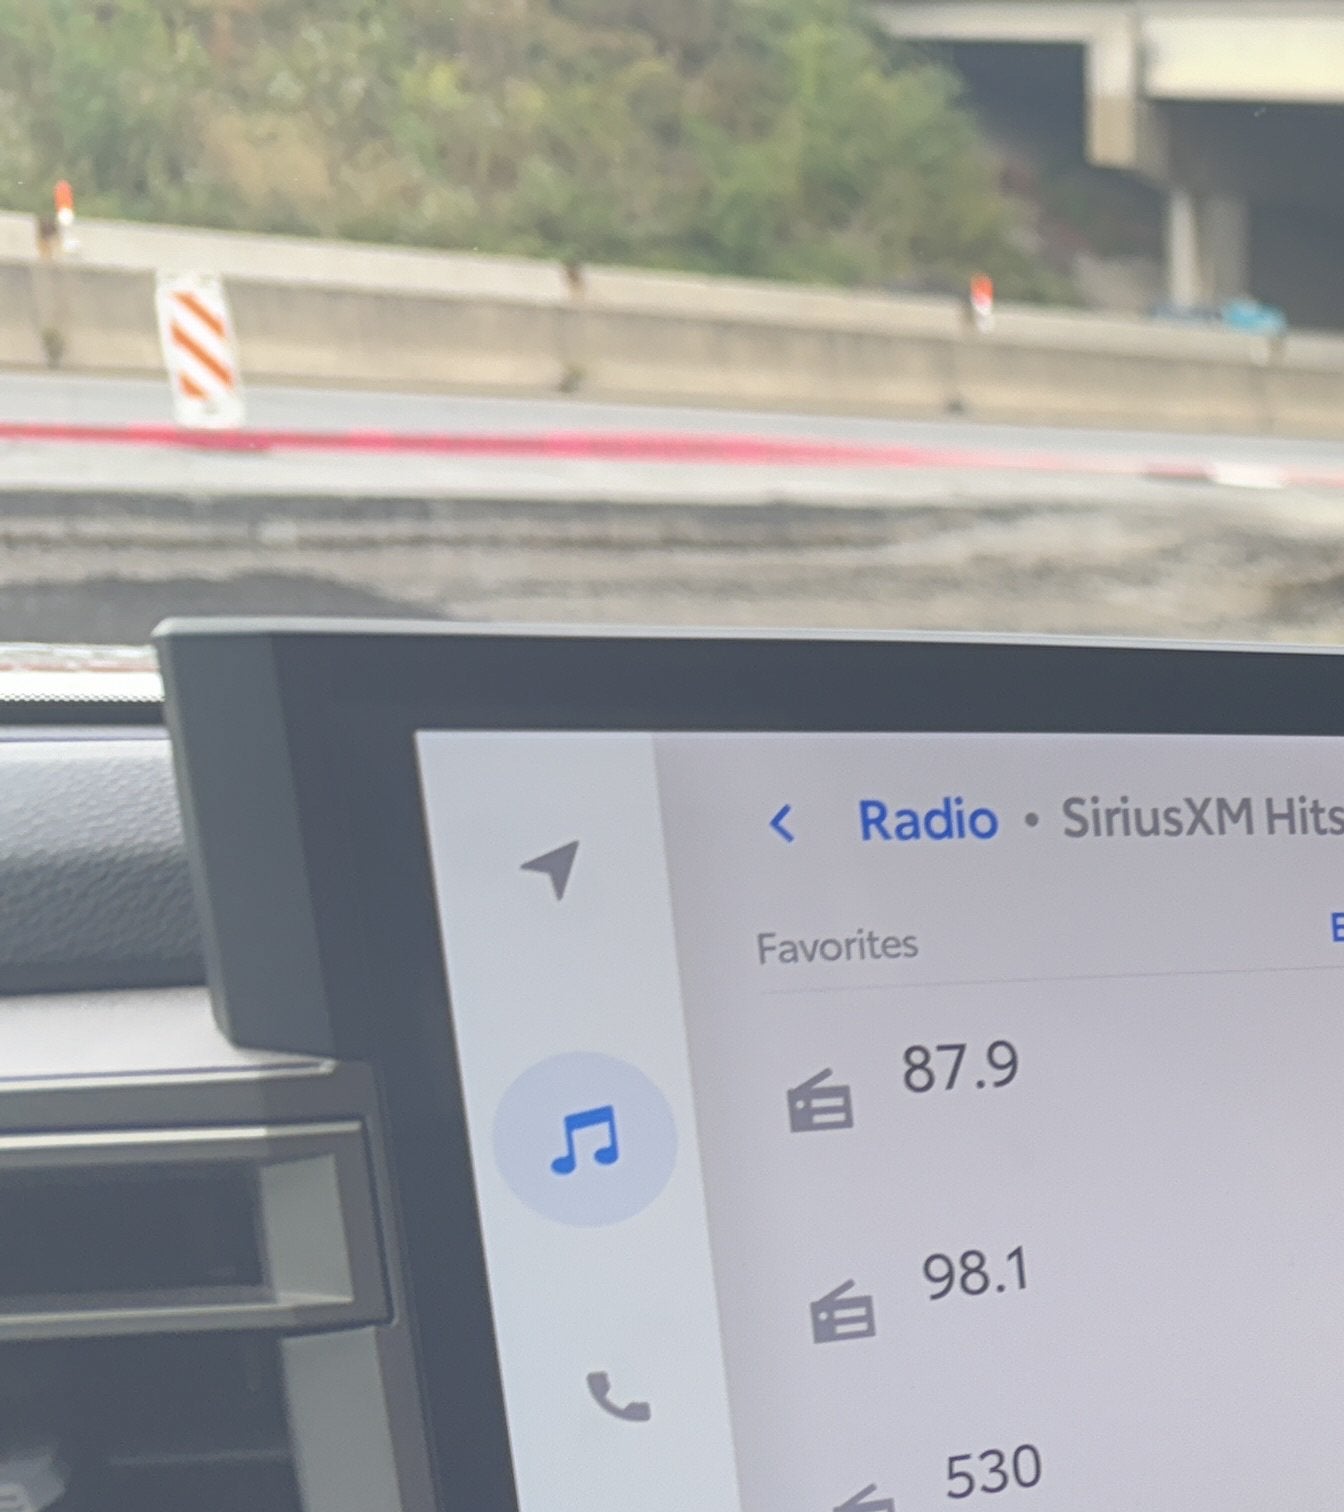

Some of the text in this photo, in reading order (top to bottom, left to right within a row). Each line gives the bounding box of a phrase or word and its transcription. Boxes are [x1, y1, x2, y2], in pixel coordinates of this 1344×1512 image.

[860, 797, 999, 842] Radio
[1063, 796, 1255, 838] SiriusXM
[757, 930, 919, 966] Favorites
[902, 1040, 1020, 1093] 87.9
[923, 1246, 1028, 1300] 98.1
[945, 1443, 1043, 1499] 530
